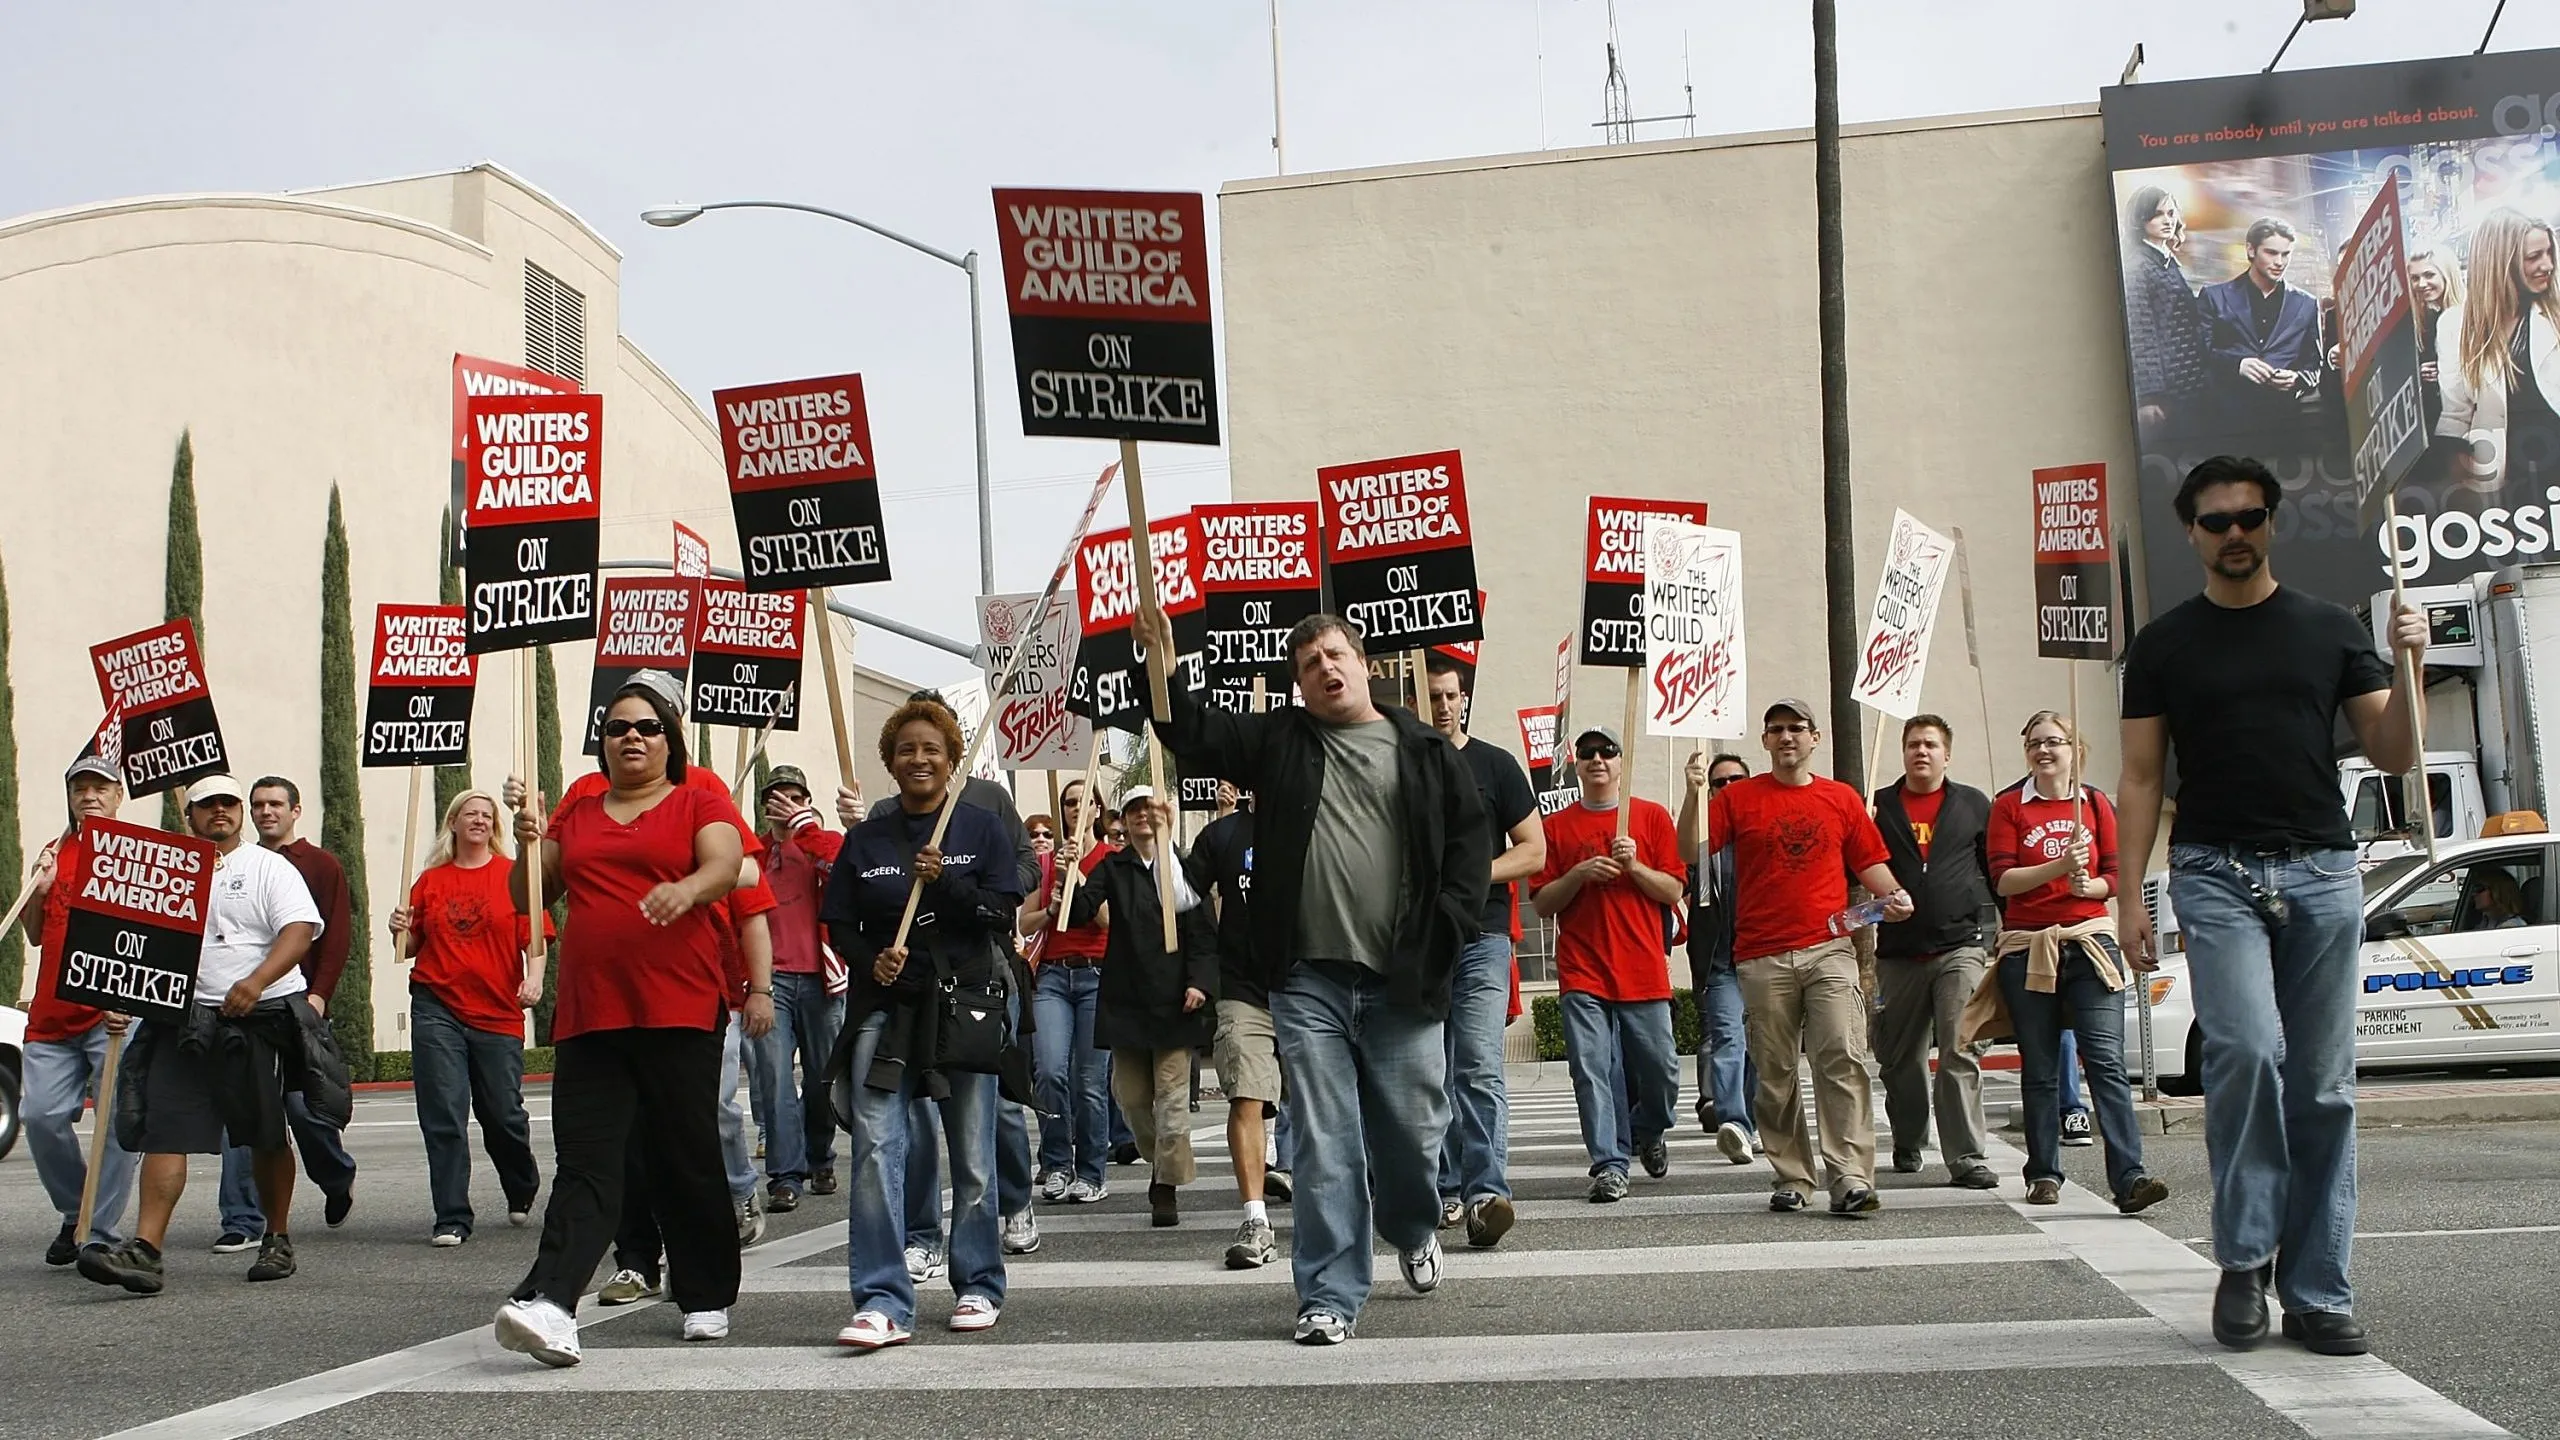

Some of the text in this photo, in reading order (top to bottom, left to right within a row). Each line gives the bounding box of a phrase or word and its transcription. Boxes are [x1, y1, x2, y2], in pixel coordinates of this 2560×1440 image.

[2138, 106, 2479, 148] You are nobody until you are talked about.
[1009, 204, 1183, 243] WRITERS
[1023, 236, 1182, 274] GUILD OF
[2337, 203, 2393, 313] WRITERS
[1020, 269, 1197, 307] AMERICA
[2343, 244, 2394, 342] GUILD OF
[2344, 270, 2404, 383] AMERICA
[1088, 333, 1132, 369] ON
[726, 389, 851, 427] WRITERS
[1030, 369, 1207, 426] STRIKE
[2366, 365, 2384, 418] ON
[476, 412, 589, 445] WRITERS
[737, 420, 852, 452] GUILD OF
[2354, 375, 2418, 508] STRIKE
[482, 445, 586, 478] GUILD OF
[737, 442, 866, 479] AMERICA
[475, 475, 593, 510] AMERICA
[1329, 465, 1450, 502] WRITERS
[2038, 477, 2098, 505] WRITERS
[788, 498, 821, 527] ON
[1200, 514, 1307, 537] WRITERS
[1339, 495, 1450, 526] GUILD OF
[2041, 504, 2098, 529] GUILD OF
[1206, 537, 1305, 560] GUILD OF
[1337, 513, 1461, 550] AMERICA
[2038, 527, 2104, 552] AMERICA
[517, 537, 548, 573] ON
[750, 525, 880, 577] STRIKE
[1083, 526, 1188, 572] WRIERS
[1091, 557, 1188, 596] GUID OF
[1202, 557, 1312, 582] AMERICA
[1386, 565, 1418, 593] ON
[1687, 568, 1706, 585] THE
[1885, 564, 1924, 609] WRITERS
[1908, 561, 1921, 579] THE
[473, 573, 591, 634] STRIKE
[609, 589, 689, 612] WRITERS
[703, 588, 796, 613] WRITERS
[1651, 580, 1718, 616] WRITERS
[2059, 575, 2077, 601] ON
[609, 611, 685, 634] GUILD OF
[707, 607, 792, 632] GUILD OF
[1243, 601, 1271, 625] ON
[1346, 589, 1474, 640] STRIKE
[1650, 613, 1703, 645] GUILD
[1876, 594, 1908, 631] GUILD
[2041, 606, 2107, 642] STRIKE
[99, 632, 186, 673] WRITERS
[386, 635, 448, 656] GUILD
[601, 634, 686, 657] AMERICA
[701, 626, 797, 650] AMERICA
[1207, 628, 1294, 665] STRIK
[1589, 618, 1646, 653] STR
[110, 656, 188, 691] GUILD OF
[377, 656, 471, 676] AMERICA
[733, 663, 759, 684] ON
[987, 644, 1057, 669] WRERS
[408, 695, 434, 718] ON
[698, 683, 795, 719] STRIKE
[150, 717, 175, 742] ON
[370, 721, 465, 754] STRIKE
[128, 731, 221, 786] STRIKE
[92, 829, 201, 874] WRITERS
[2023, 825, 2046, 848] GOOD
[92, 855, 196, 896] GUILD OF
[81, 877, 198, 921] AMERICA
[115, 930, 148, 960] ON
[2372, 952, 2414, 964] Burbank
[66, 951, 188, 1009] STRIKE
[2363, 964, 2534, 994] POLICE
[2356, 1022, 2423, 1036] NFORCEMENT
[2364, 1009, 2407, 1023] PARKING
